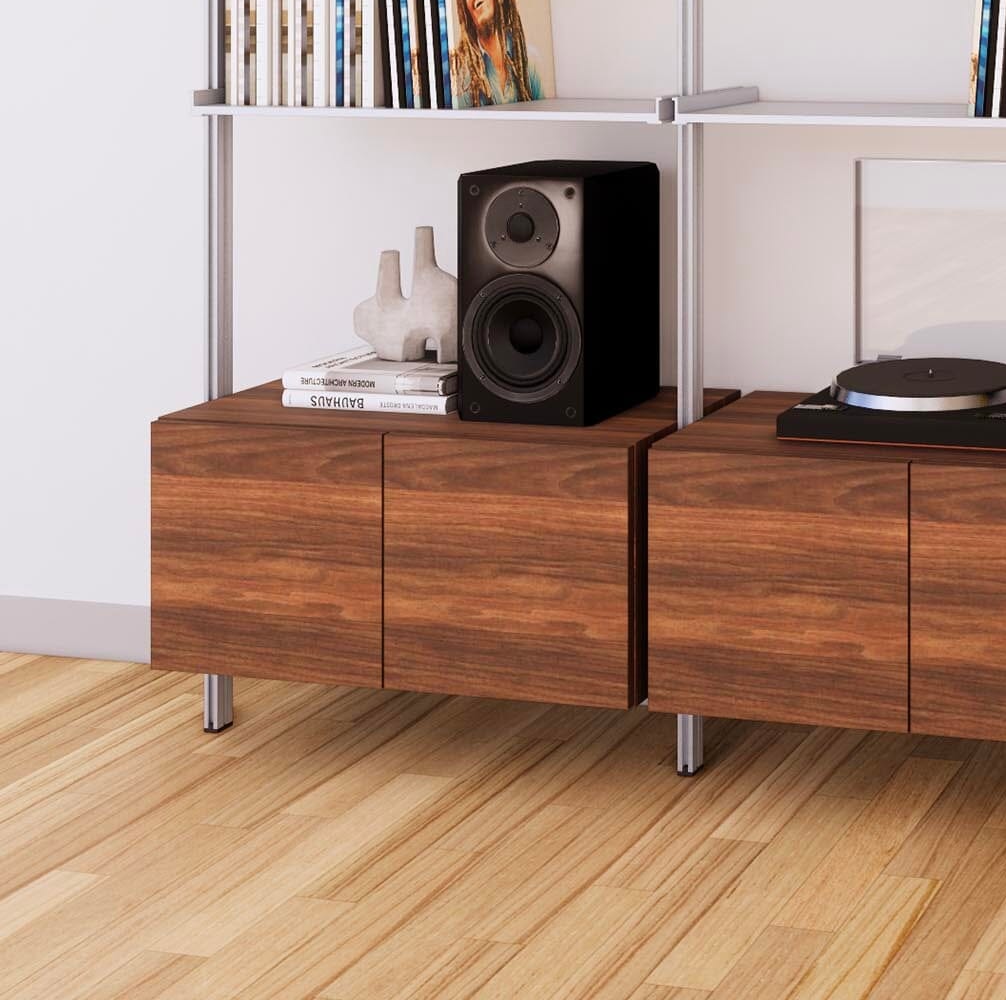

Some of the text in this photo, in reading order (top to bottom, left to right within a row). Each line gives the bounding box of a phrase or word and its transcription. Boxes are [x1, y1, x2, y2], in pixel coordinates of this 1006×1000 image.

[300, 376, 376, 388] MODERN ARCHITECTURE
[310, 394, 364, 408] BAUHAUS
